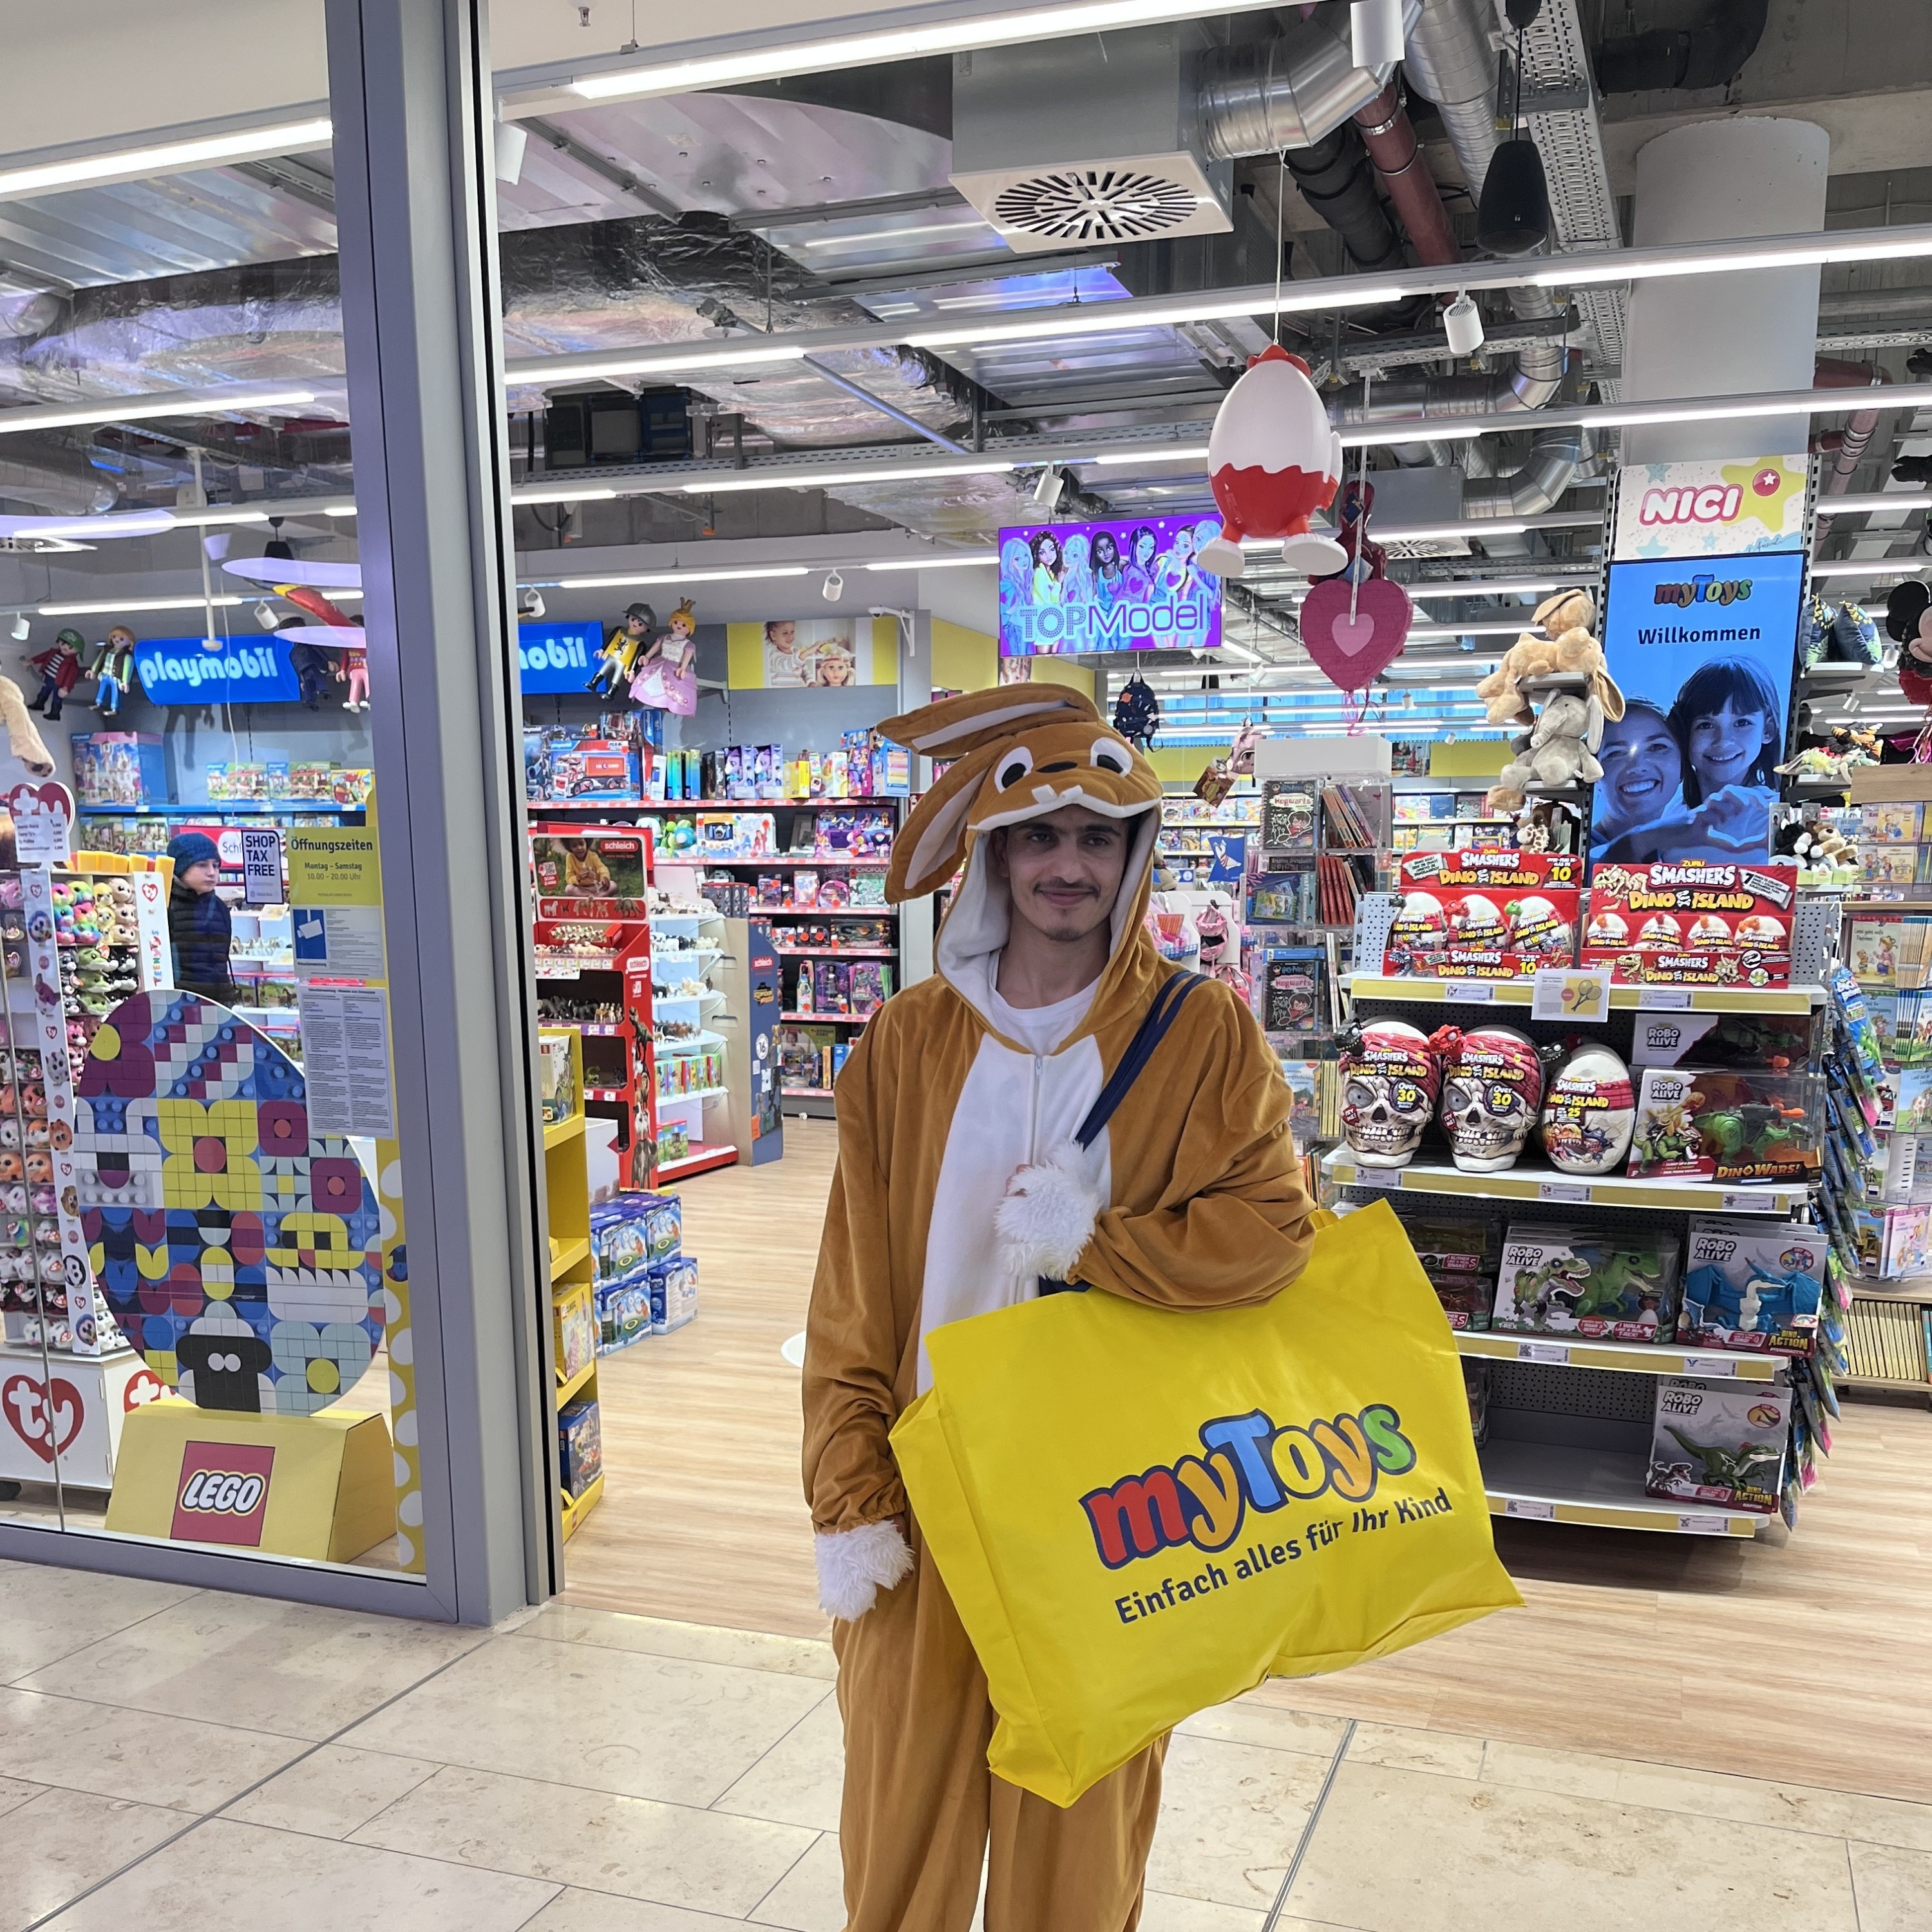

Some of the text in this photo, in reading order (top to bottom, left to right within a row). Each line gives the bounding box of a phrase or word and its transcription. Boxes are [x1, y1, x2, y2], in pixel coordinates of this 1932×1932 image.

[1641, 486, 1742, 524] NICI
[1654, 574, 1752, 607] myToys
[1638, 627, 1761, 645] Willkommen
[140, 647, 278, 688] playmobil
[1274, 797, 1311, 806] Hogwarts
[245, 835, 276, 848] SHOP
[291, 837, 373, 853] Öffnungszeiten
[604, 841, 635, 850] schleich
[246, 849, 269, 862] TAX
[1461, 851, 1520, 868] SMASHERS
[247, 864, 276, 876] FREE
[305, 862, 363, 871] Montag Samstag
[1439, 869, 1478, 885] DINO
[1490, 871, 1540, 886] ISLAND
[1551, 866, 1571, 881] 10
[1650, 865, 1736, 887] SMASHERS
[1743, 873, 1755, 884] 7
[1629, 891, 1754, 910] DINO ISLAND
[1409, 923, 1434, 932] ISLAND
[1466, 919, 1497, 929] SMASHERS
[1535, 920, 1559, 933] ISLAND
[1458, 926, 1504, 939] DINO ISLAND
[1531, 936, 1540, 944] 10
[1450, 950, 1502, 964] SMASHERS
[1658, 955, 1708, 969] SMASHERS
[1437, 965, 1514, 978] DINO ISLAND
[1519, 962, 1537, 974] 10
[1275, 979, 1312, 988] Hogwarts
[1645, 971, 1720, 983] DINO ISLAND
[1647, 1027, 1680, 1039] ROBO
[759, 1041, 766, 1053] 16
[1647, 1037, 1679, 1047] ALIVE
[1363, 1050, 1408, 1062] SMASHERS
[1461, 1053, 1504, 1065] SMASHERS
[1350, 1064, 1427, 1077] DINO ISLAND
[1448, 1065, 1525, 1081] DINO ISLAND
[1493, 1085, 1512, 1094] Over
[1557, 1081, 1596, 1094] SMASHERS
[1652, 1081, 1683, 1092] ROBO
[1397, 1089, 1416, 1102] 30
[1492, 1093, 1512, 1106] 30
[1651, 1089, 1681, 1099] ALIVE
[1571, 1095, 1609, 1108] ISLAND
[1567, 1107, 1581, 1117] 25
[1696, 1238, 1736, 1251] ROBO
[1508, 1246, 1543, 1258] ROBO
[1694, 1249, 1732, 1261] ALIVE
[1506, 1256, 1540, 1267] ALIVE
[1768, 1335, 1808, 1350] ACTION
[1663, 1390, 1703, 1405] ROBO
[8, 1380, 74, 1446] ty
[1661, 1402, 1698, 1415] ALIVE
[182, 1470, 264, 1515] LEGO
[1079, 1404, 1417, 1570] myToys
[1734, 1490, 1772, 1506] ACTION
[1115, 1487, 1453, 1625] Einfach alles für Ihr Kind
